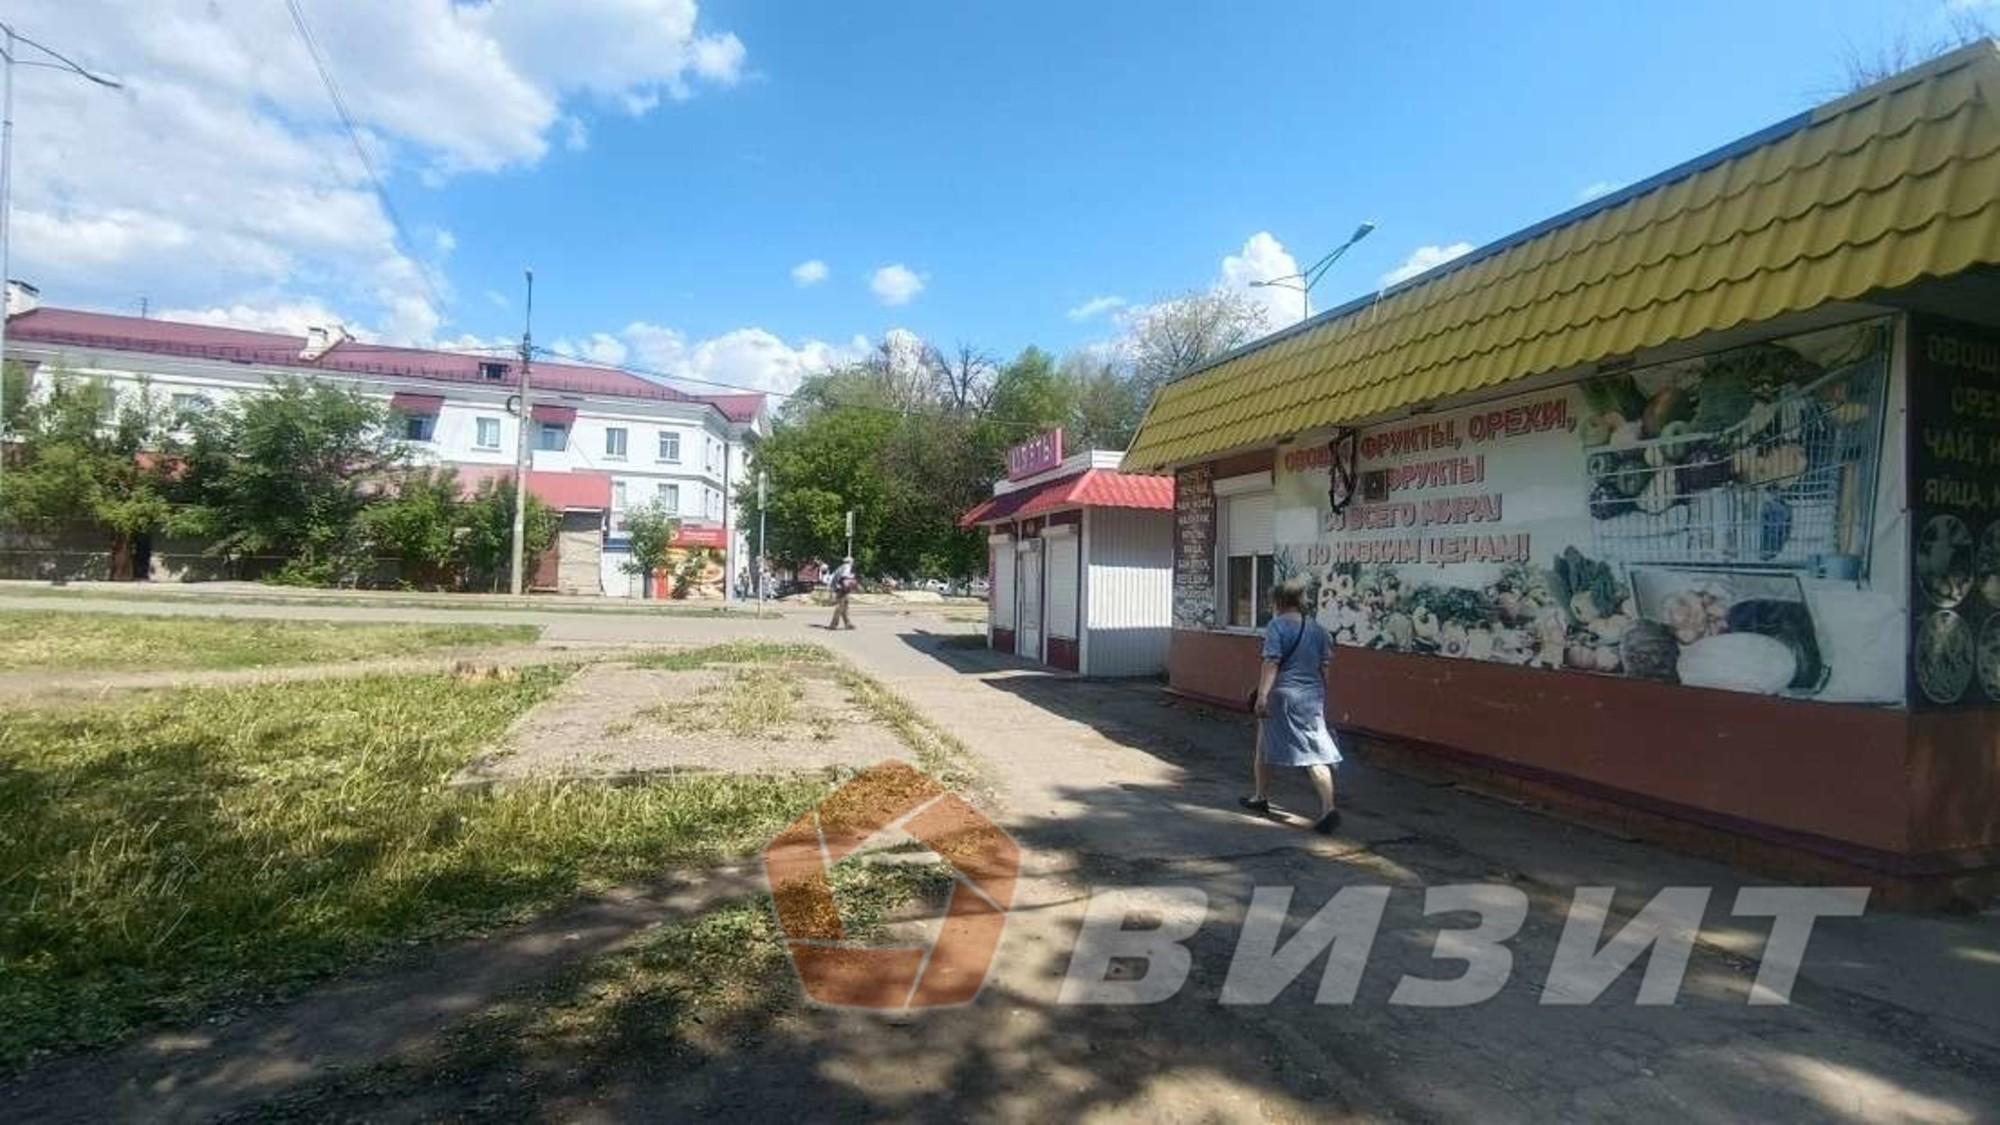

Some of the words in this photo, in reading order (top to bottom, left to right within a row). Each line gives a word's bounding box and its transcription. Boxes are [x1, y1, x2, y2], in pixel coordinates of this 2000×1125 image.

[1468, 398, 1577, 441] ОРЕХИ,
[1420, 493, 1503, 527] МИРА!
[1427, 533, 1531, 568] ЦЕНАМ!
